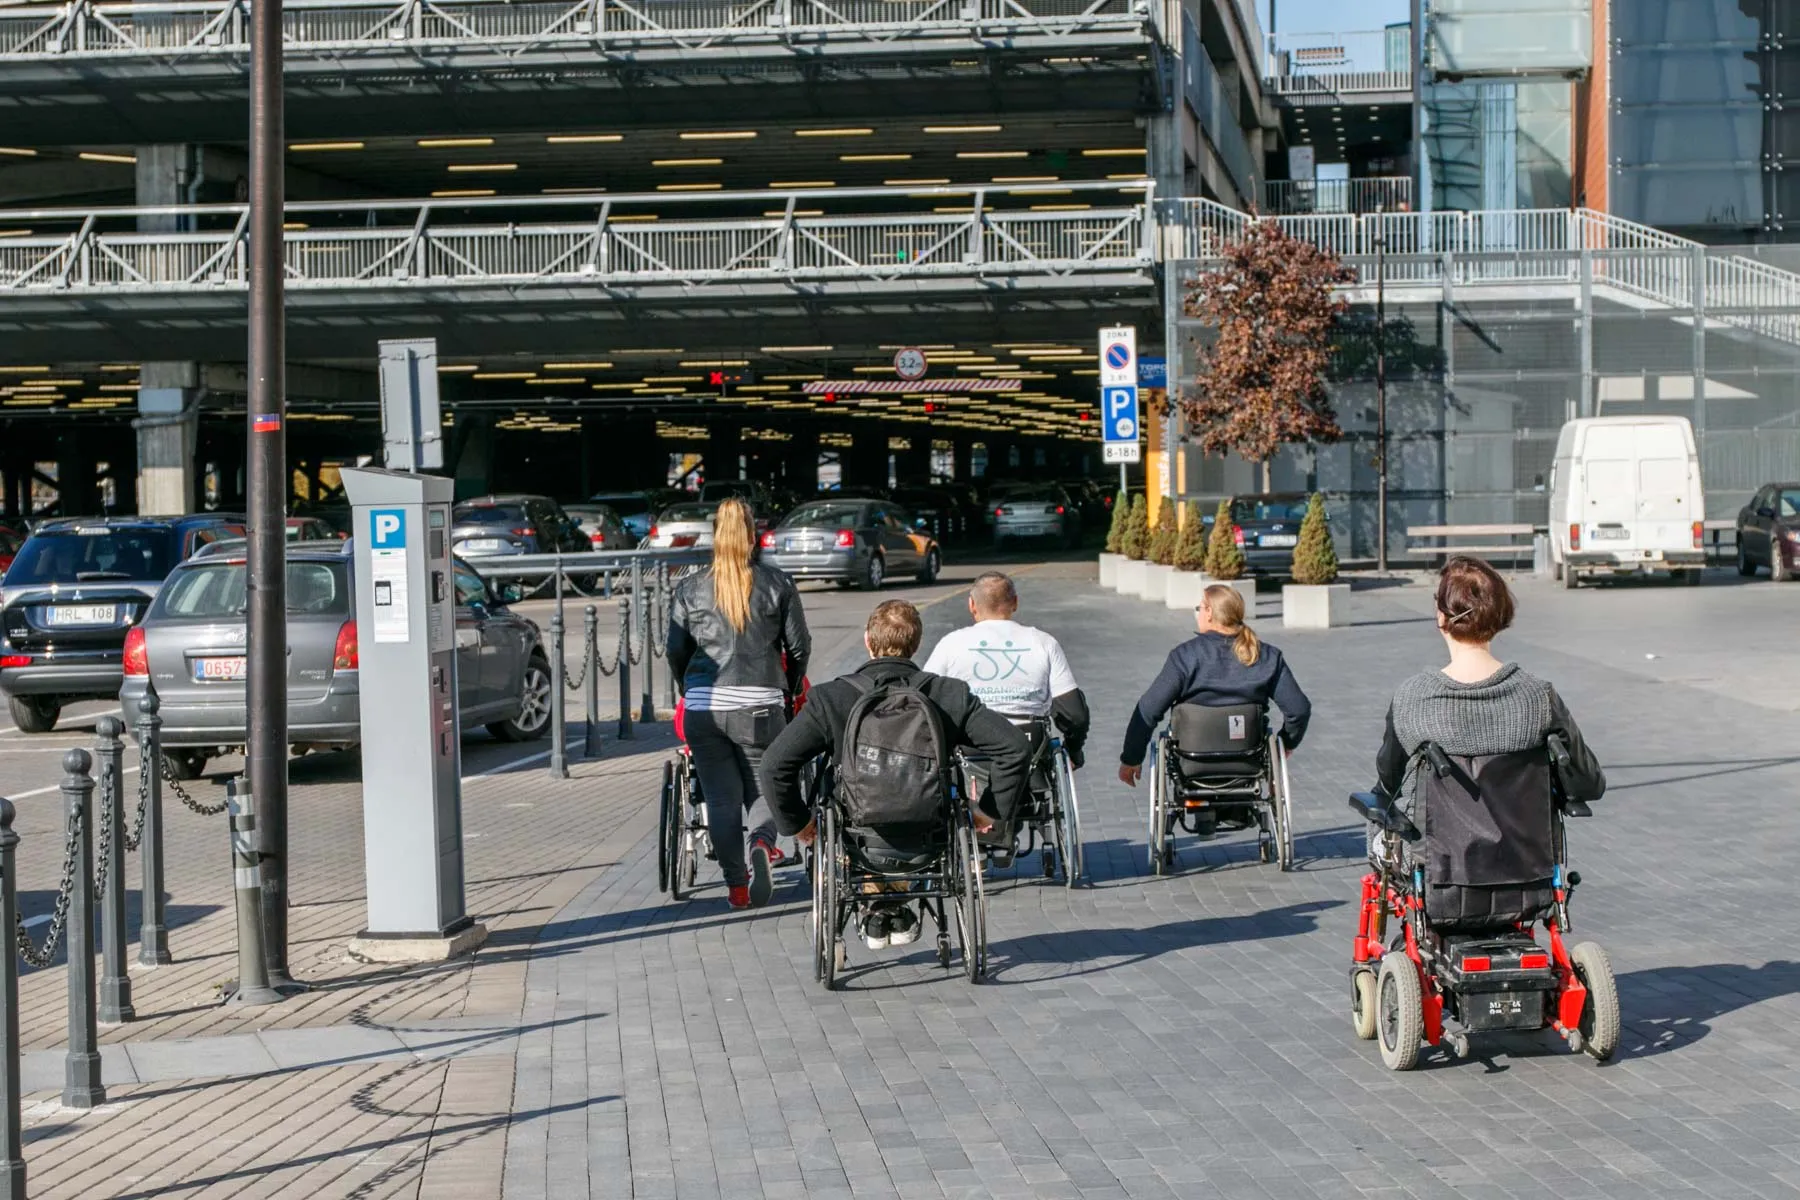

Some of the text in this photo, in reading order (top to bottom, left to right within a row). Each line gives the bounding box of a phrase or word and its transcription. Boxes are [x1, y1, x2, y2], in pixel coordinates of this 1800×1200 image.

[1110, 389, 1130, 419] P
[375, 514, 400, 543] P
[56, 607, 113, 620] HRL 108
[205, 661, 247, 675] 0657
